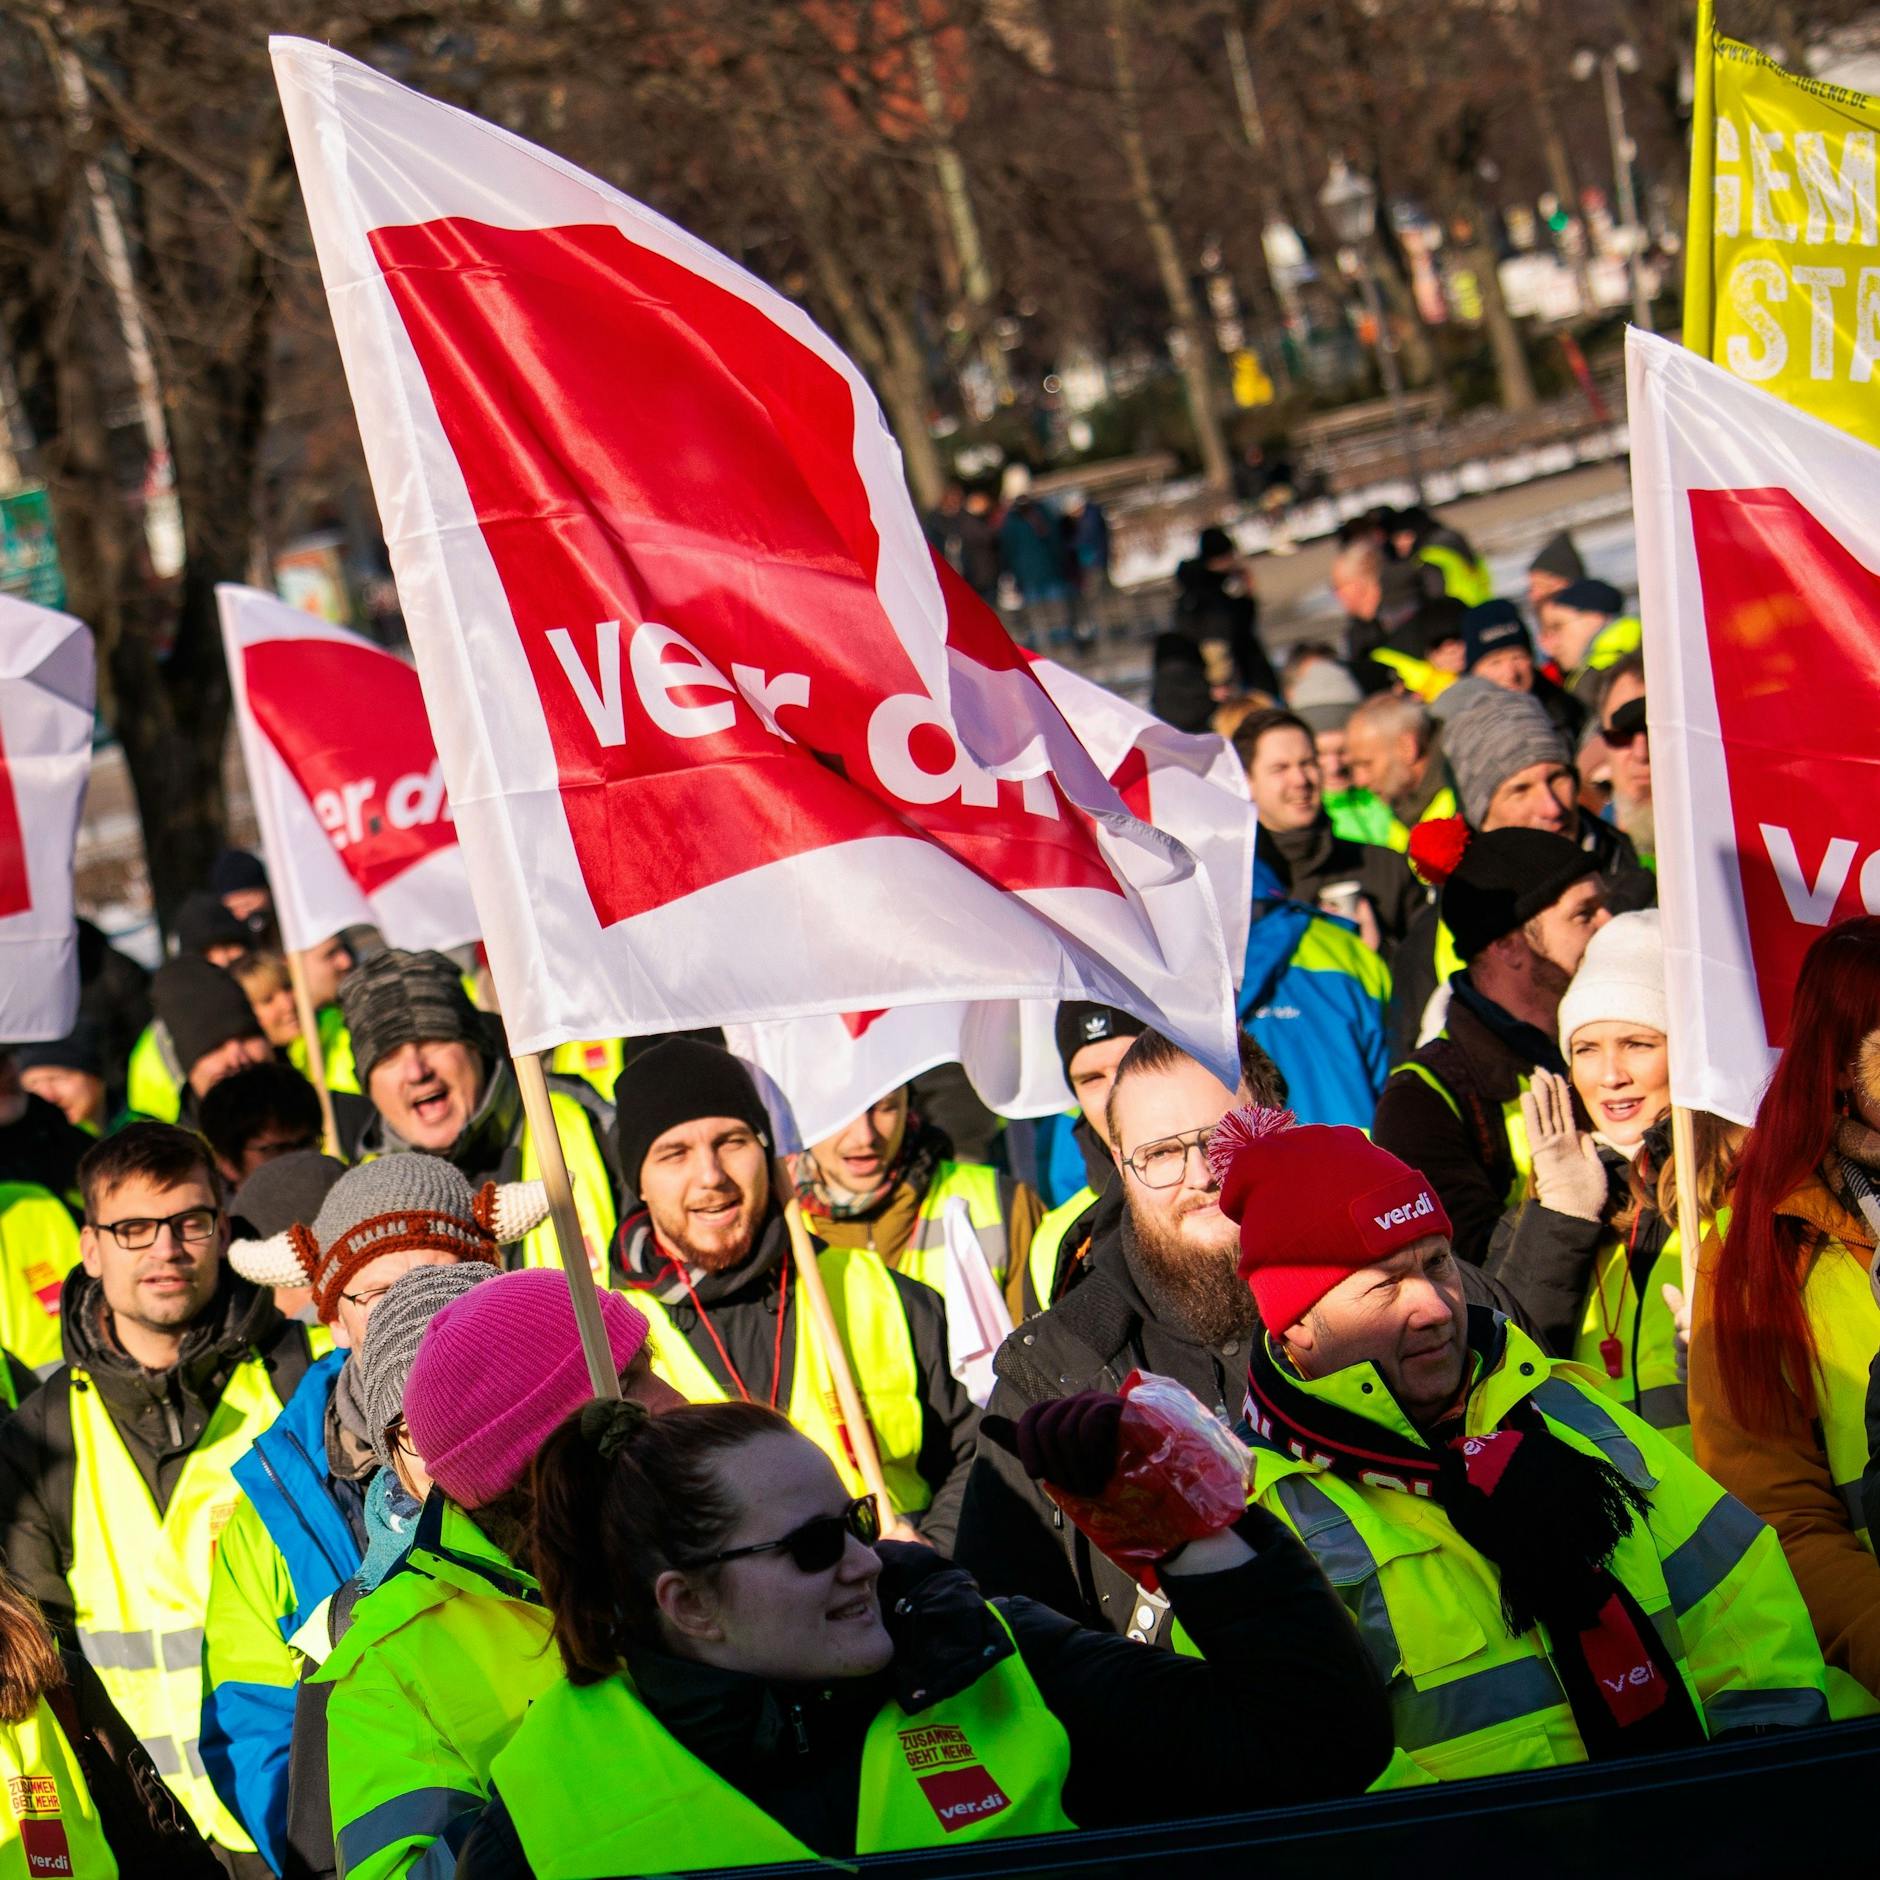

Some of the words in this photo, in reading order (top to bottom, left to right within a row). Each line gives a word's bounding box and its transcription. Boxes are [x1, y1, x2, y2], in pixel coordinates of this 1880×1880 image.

[1373, 1191, 1435, 1231] ver.di
[900, 1729, 968, 1751] ZUSAMMEN
[906, 1747, 939, 1766] GEHT
[941, 1744, 974, 1760] MEHR
[36, 1795, 60, 1808] MEHR
[940, 1793, 1004, 1819] ver.di
[30, 1853, 69, 1870] ver.di
